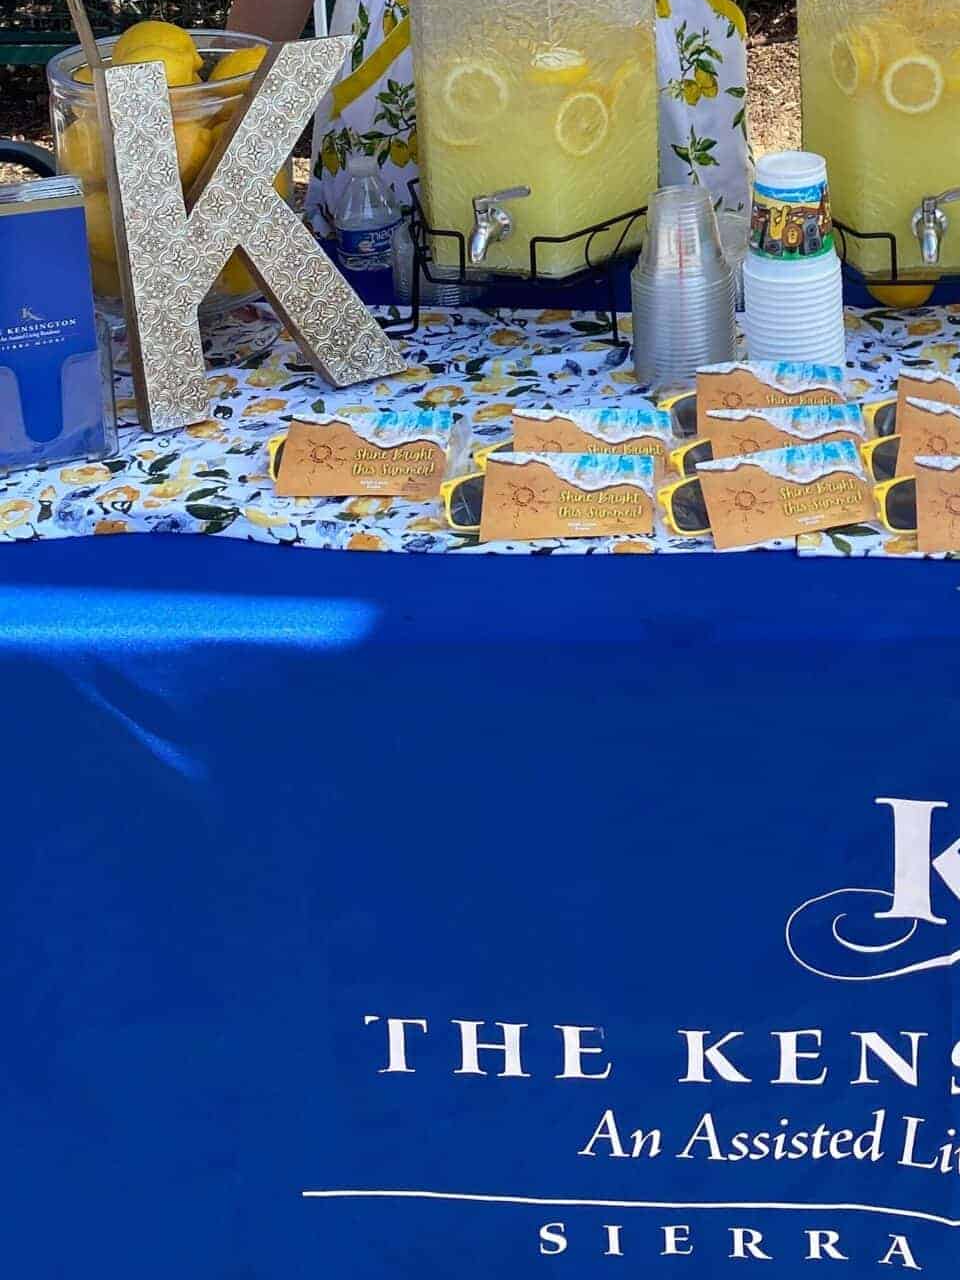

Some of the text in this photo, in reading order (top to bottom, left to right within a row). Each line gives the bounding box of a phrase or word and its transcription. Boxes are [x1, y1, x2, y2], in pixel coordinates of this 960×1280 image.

[97, 34, 408, 433] K
[7, 319, 77, 335] KENSINGTON
[364, 1014, 613, 1080] THE
[577, 1108, 662, 1158] An
[676, 1108, 886, 1163] Assisted
[538, 1222, 923, 1271] SIERRA
